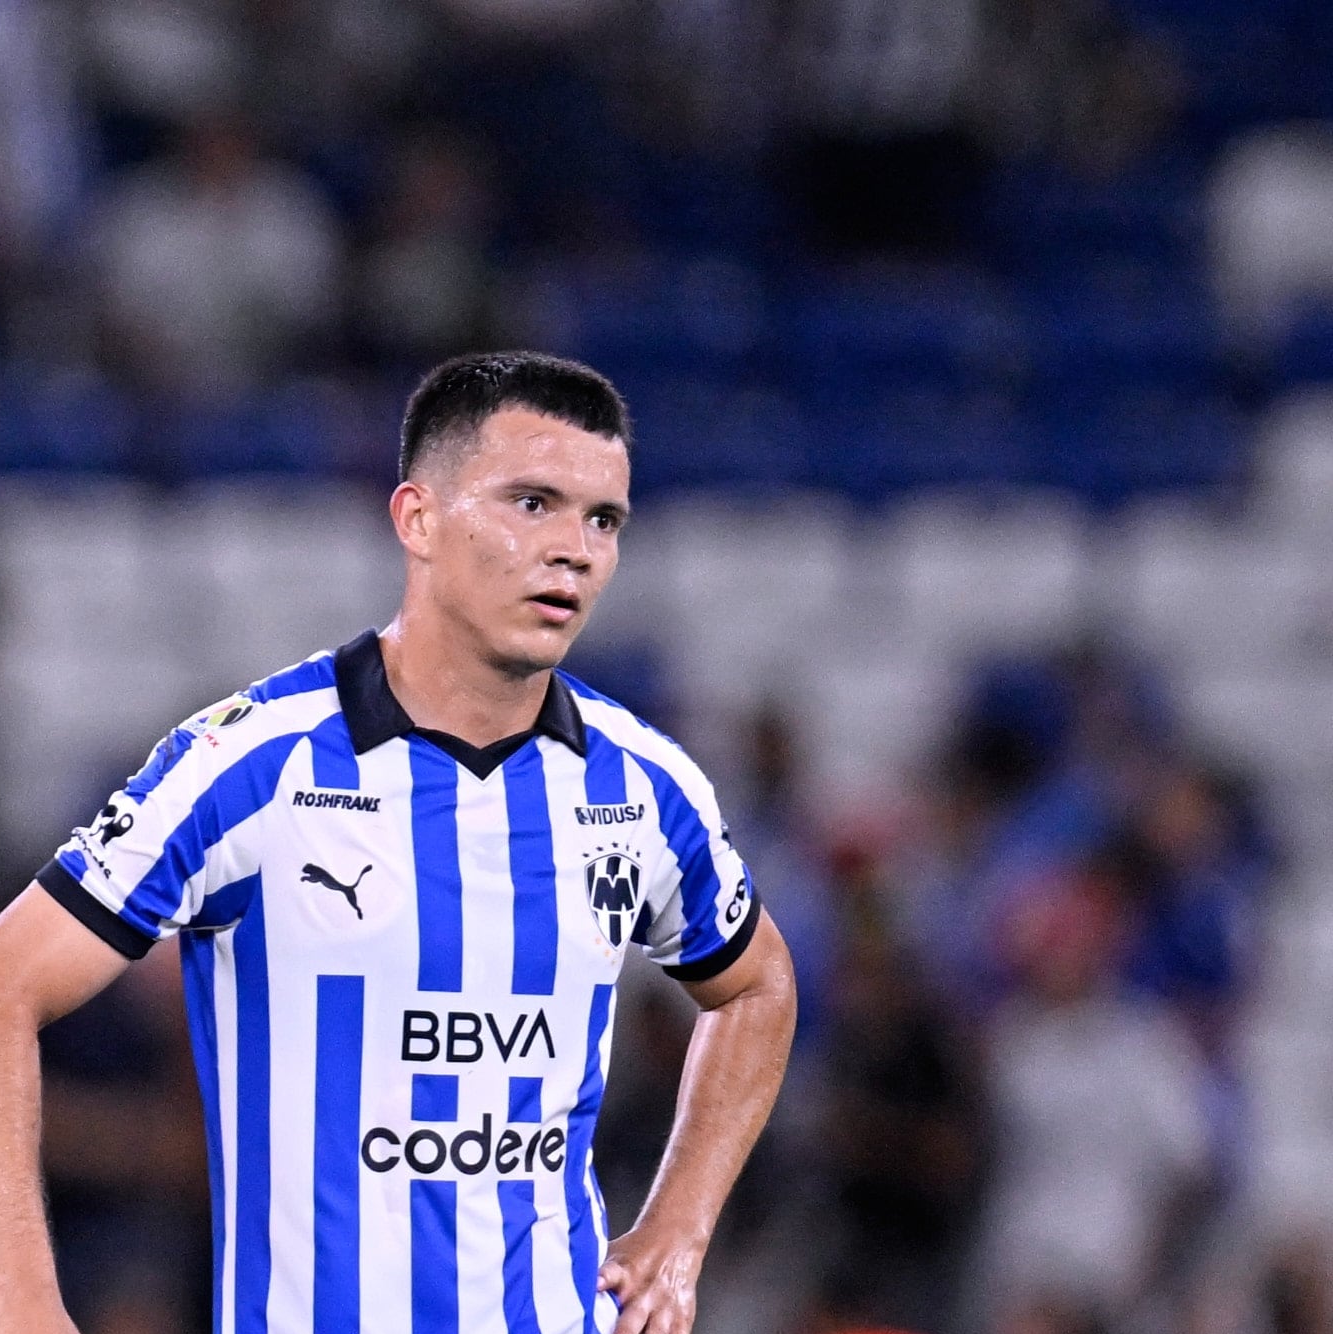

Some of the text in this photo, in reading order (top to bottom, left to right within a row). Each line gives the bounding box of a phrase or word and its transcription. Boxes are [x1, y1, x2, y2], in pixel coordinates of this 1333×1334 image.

[293, 791, 382, 813] ROSHFRANS
[587, 804, 646, 826] VIDUSA
[401, 1007, 556, 1064] BBVA
[361, 1112, 567, 1176] codere
